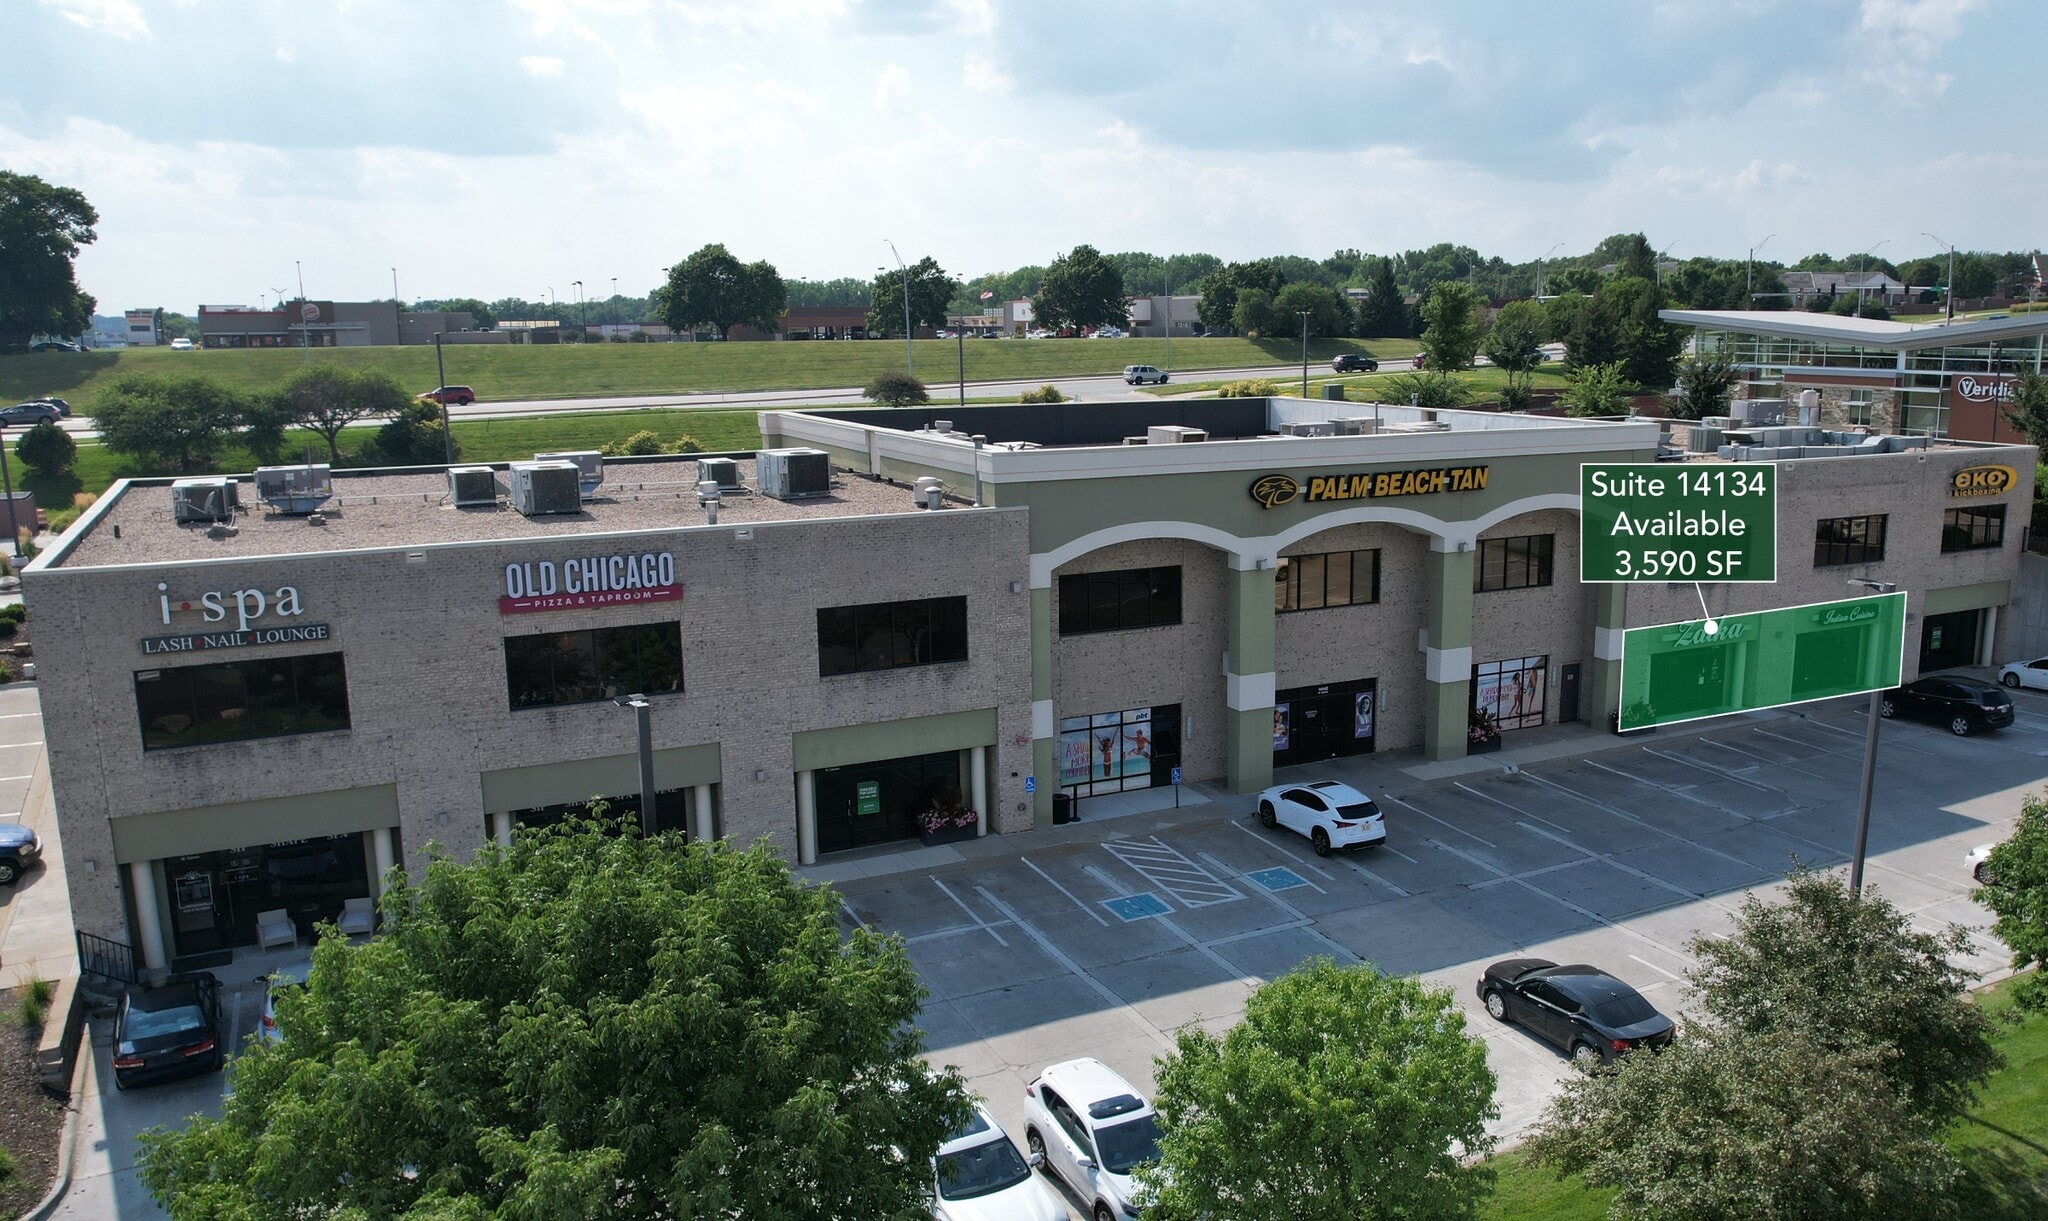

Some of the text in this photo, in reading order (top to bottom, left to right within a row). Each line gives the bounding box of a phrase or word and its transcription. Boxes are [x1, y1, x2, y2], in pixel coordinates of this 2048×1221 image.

[1308, 467, 1489, 501] PALM BEACH TAN
[1954, 487, 2001, 497] kickboxing
[506, 552, 674, 599] OLD CHICAGO
[158, 582, 305, 632] i spa
[534, 591, 652, 608] PIZZA & TAPROOM
[1824, 610, 1848, 624] Indian
[145, 626, 328, 653] LASH NAIL LOUNGE
[1135, 712, 1148, 720] pbt
